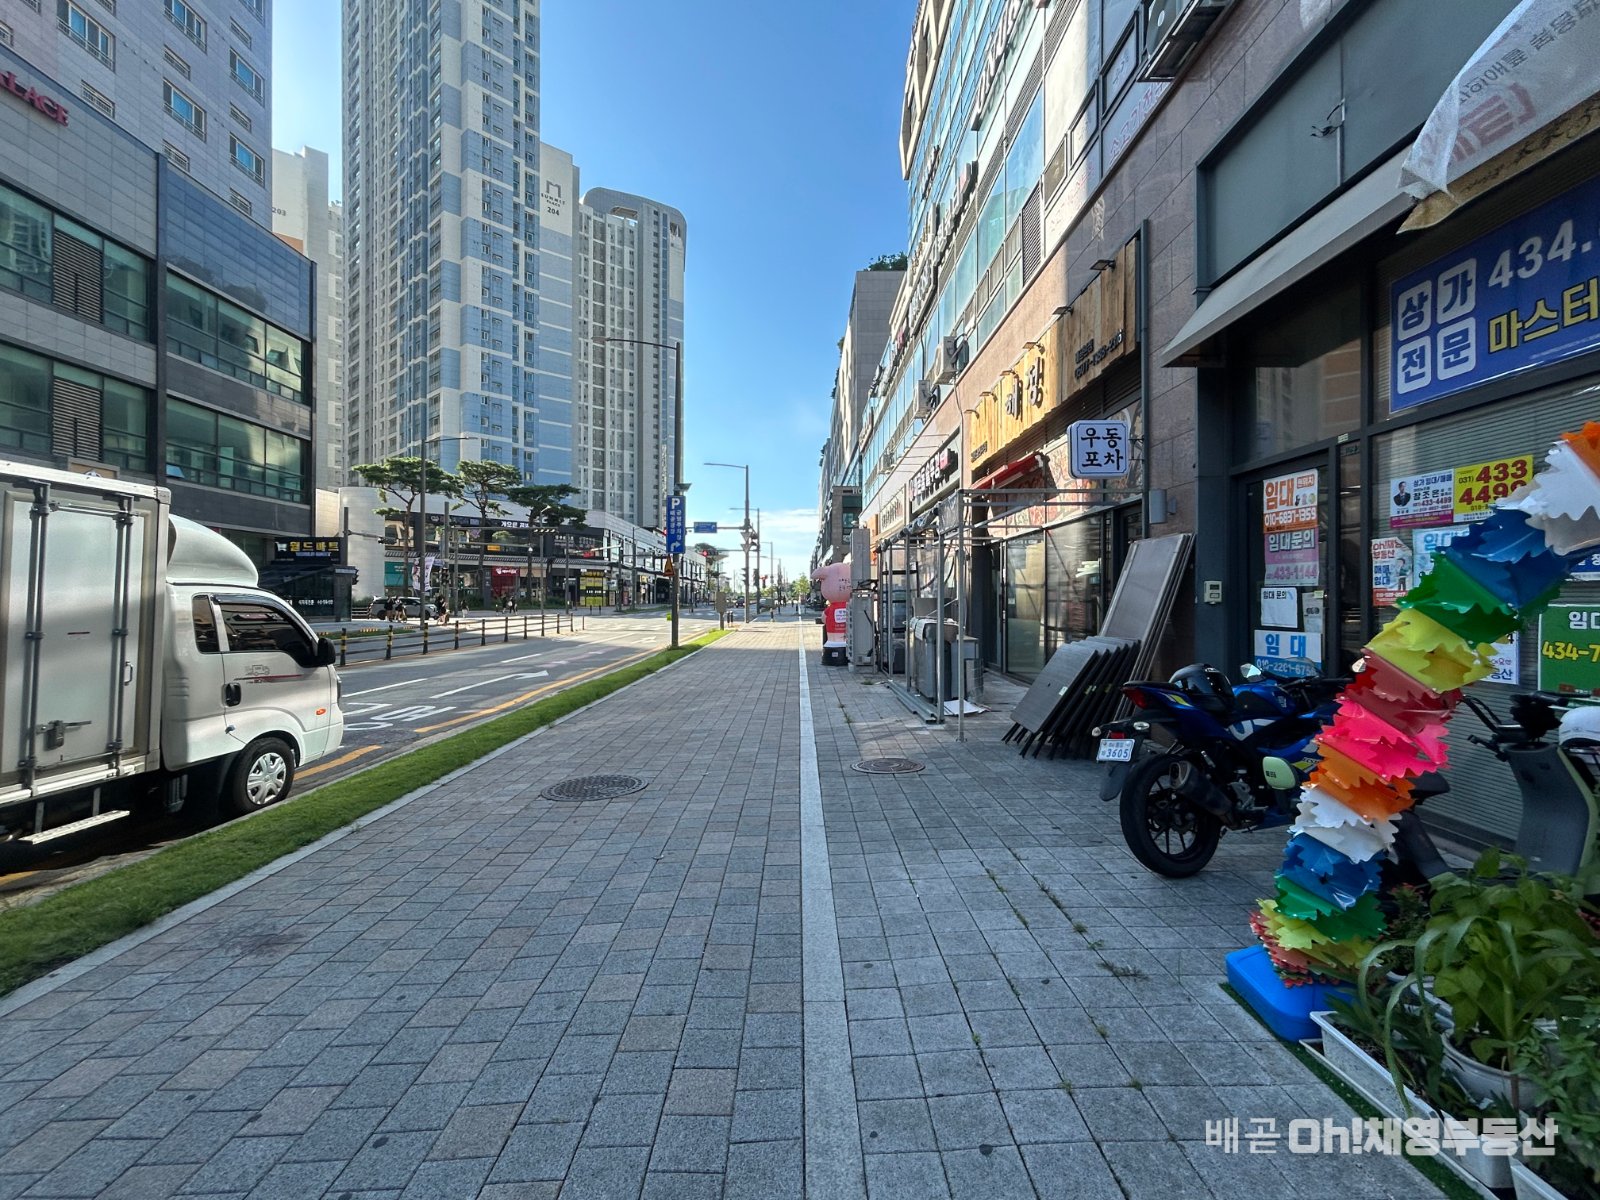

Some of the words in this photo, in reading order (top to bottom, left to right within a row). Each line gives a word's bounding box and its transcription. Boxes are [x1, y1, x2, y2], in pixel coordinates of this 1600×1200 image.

[547, 206, 560, 216] 204
[1401, 271, 1473, 332] 상가
[1401, 327, 1471, 382] 전문
[1081, 427, 1122, 449] 우동
[1081, 448, 1124, 471] 포차
[1475, 459, 1528, 484] 433
[671, 497, 680, 510] P
[1265, 477, 1295, 511] 임대
[289, 541, 340, 552] 월드마트
[1268, 529, 1315, 552] 임대문의
[1263, 590, 1275, 600] 임대
[1106, 748, 1129, 759] 3605
